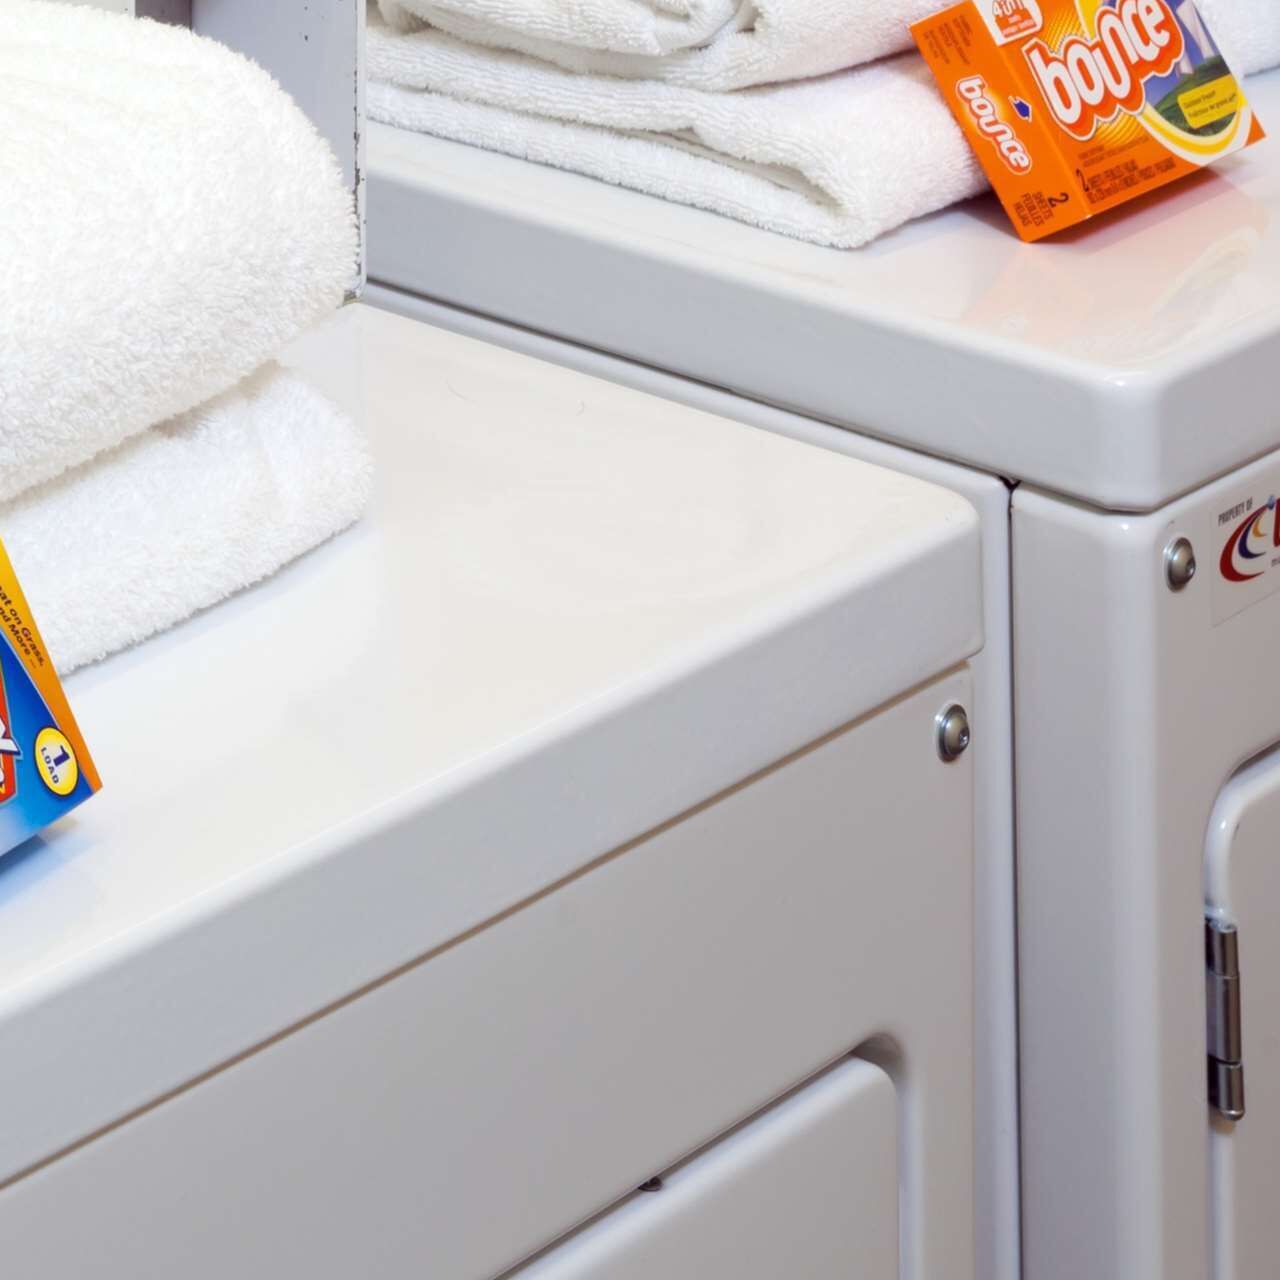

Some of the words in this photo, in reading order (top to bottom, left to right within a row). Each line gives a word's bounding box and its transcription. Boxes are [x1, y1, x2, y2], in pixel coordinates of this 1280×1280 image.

[958, 77, 1030, 169] bounce
[1048, 192, 1069, 208] 2
[9, 604, 23, 624] on
[8, 622, 32, 656] More
[40, 747, 60, 784] LOAD
[50, 745, 70, 768] 1
